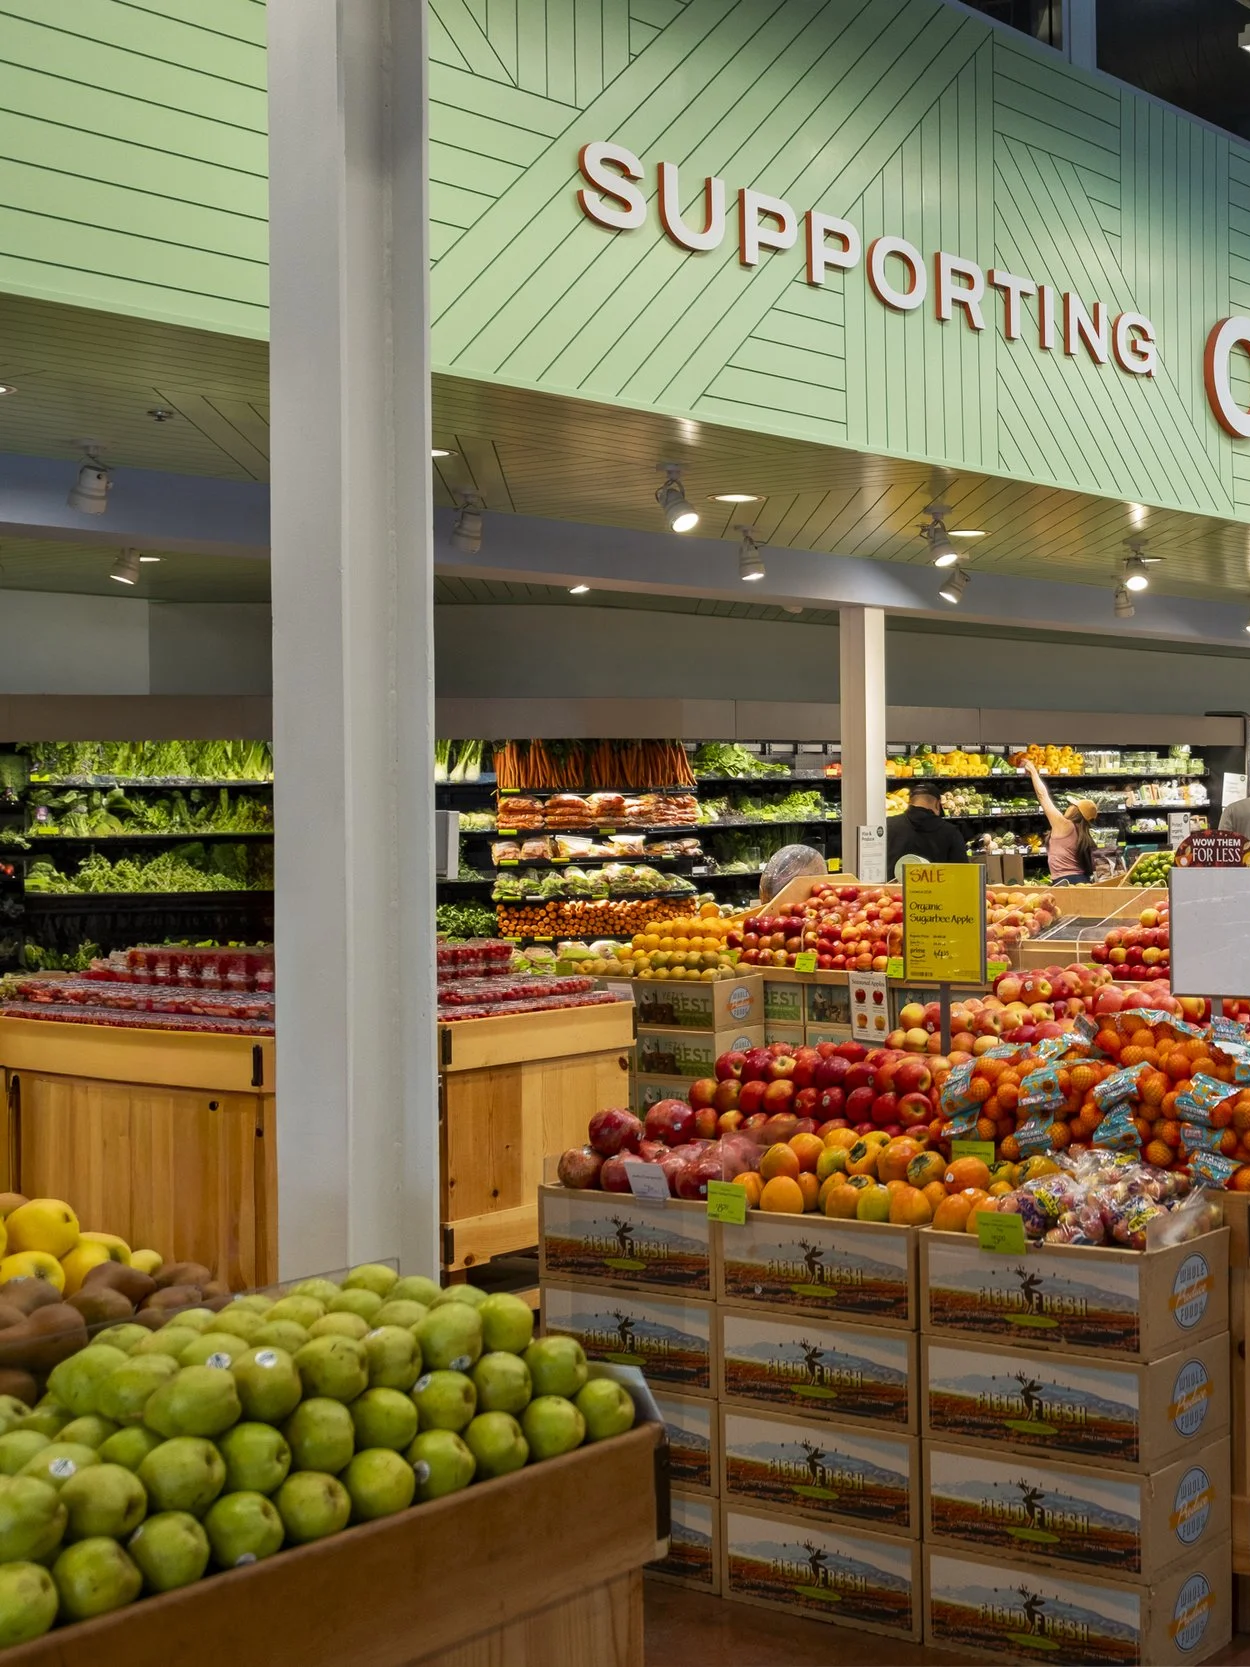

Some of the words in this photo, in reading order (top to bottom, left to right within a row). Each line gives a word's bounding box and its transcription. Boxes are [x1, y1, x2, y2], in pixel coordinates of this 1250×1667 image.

[577, 141, 1157, 376] SUPPORTING
[1192, 838, 1215, 847] WOW
[1216, 838, 1241, 847] THEM
[1192, 847, 1213, 862] FOR
[1216, 847, 1241, 863] LESS
[909, 868, 946, 883] SALE
[909, 901, 943, 912] Organic
[909, 913, 950, 925] Sugarbee
[951, 914, 975, 925] Apple
[672, 997, 710, 1013] BEST
[674, 1047, 712, 1062] BEST
[583, 1235, 619, 1252] FIELD
[625, 1238, 669, 1259] FRESH
[767, 1259, 807, 1278] FIELD
[814, 1263, 863, 1285] FRESH
[1179, 1262, 1205, 1284] WHOLE
[978, 1287, 1024, 1308] FIELD
[1032, 1292, 1088, 1316] FRESH
[1180, 1300, 1204, 1323] FOODS
[583, 1328, 620, 1347] FIELD
[626, 1332, 670, 1355] FRESH
[767, 1358, 807, 1378] FIELD
[814, 1363, 863, 1388] FRESH
[1178, 1369, 1205, 1391] WHOLE
[977, 1392, 1024, 1414] FIELD
[1032, 1397, 1088, 1424] FRESH
[1180, 1407, 1204, 1430] FOODS
[768, 1458, 809, 1478] FIELD
[816, 1466, 865, 1490] FRESH
[1180, 1476, 1206, 1499] WHOLE
[979, 1498, 1025, 1521] FIELD
[1034, 1506, 1090, 1534] FRESH
[770, 1558, 811, 1579] FIELD
[818, 1566, 867, 1593] FRESH
[1180, 1581, 1206, 1607] WHOLE
[979, 1603, 1026, 1628] FIELD
[1034, 1612, 1090, 1642] FRESH
